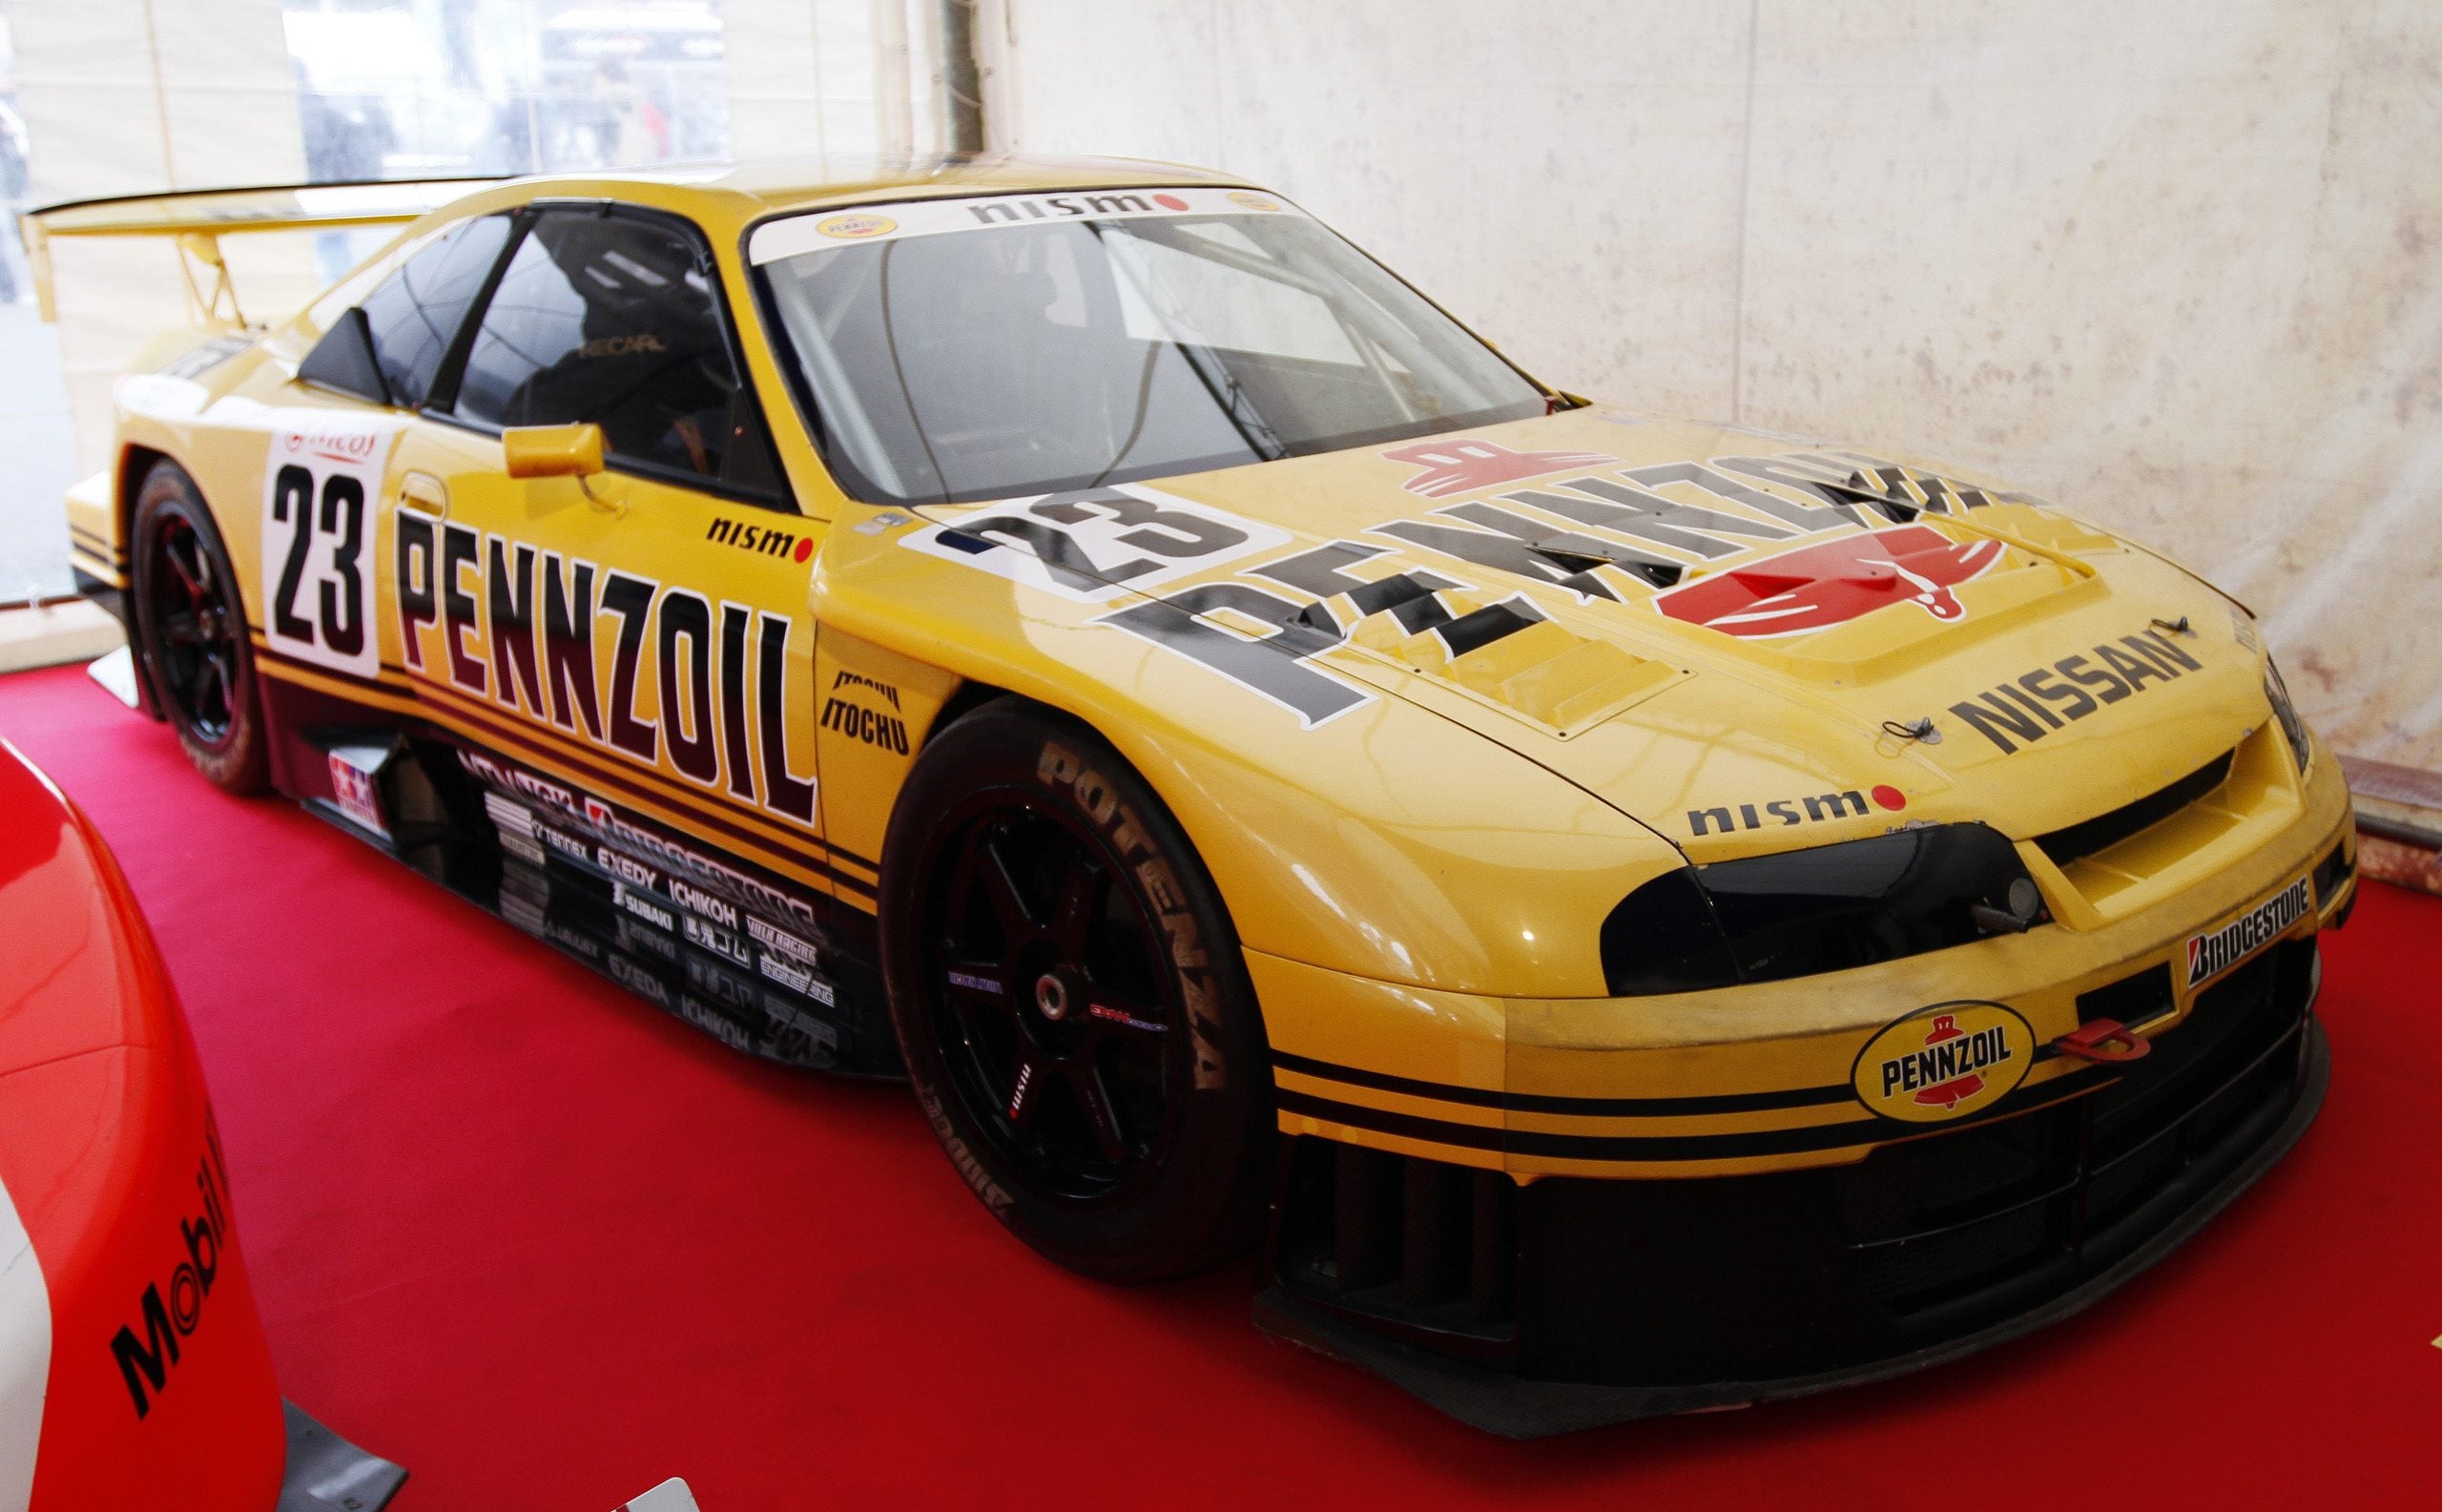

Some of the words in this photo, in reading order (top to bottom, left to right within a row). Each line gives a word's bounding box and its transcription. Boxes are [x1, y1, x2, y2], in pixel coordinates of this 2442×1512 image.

[967, 194, 1190, 224] nismo
[271, 464, 366, 658] 23
[706, 517, 814, 564] nismo
[934, 491, 1250, 592] 23
[394, 508, 818, 828] PENNZOIL
[1947, 624, 2204, 756] NISSAN
[820, 697, 910, 756] ITOCHU
[1687, 790, 1907, 837] nismo
[597, 846, 657, 891] EXEDY
[668, 878, 739, 931] ICHIKOH
[1037, 741, 1228, 1090] POTENZA
[2188, 877, 2308, 986] BRIDGESTONE
[1880, 1025, 2013, 1099] PENNZOIL
